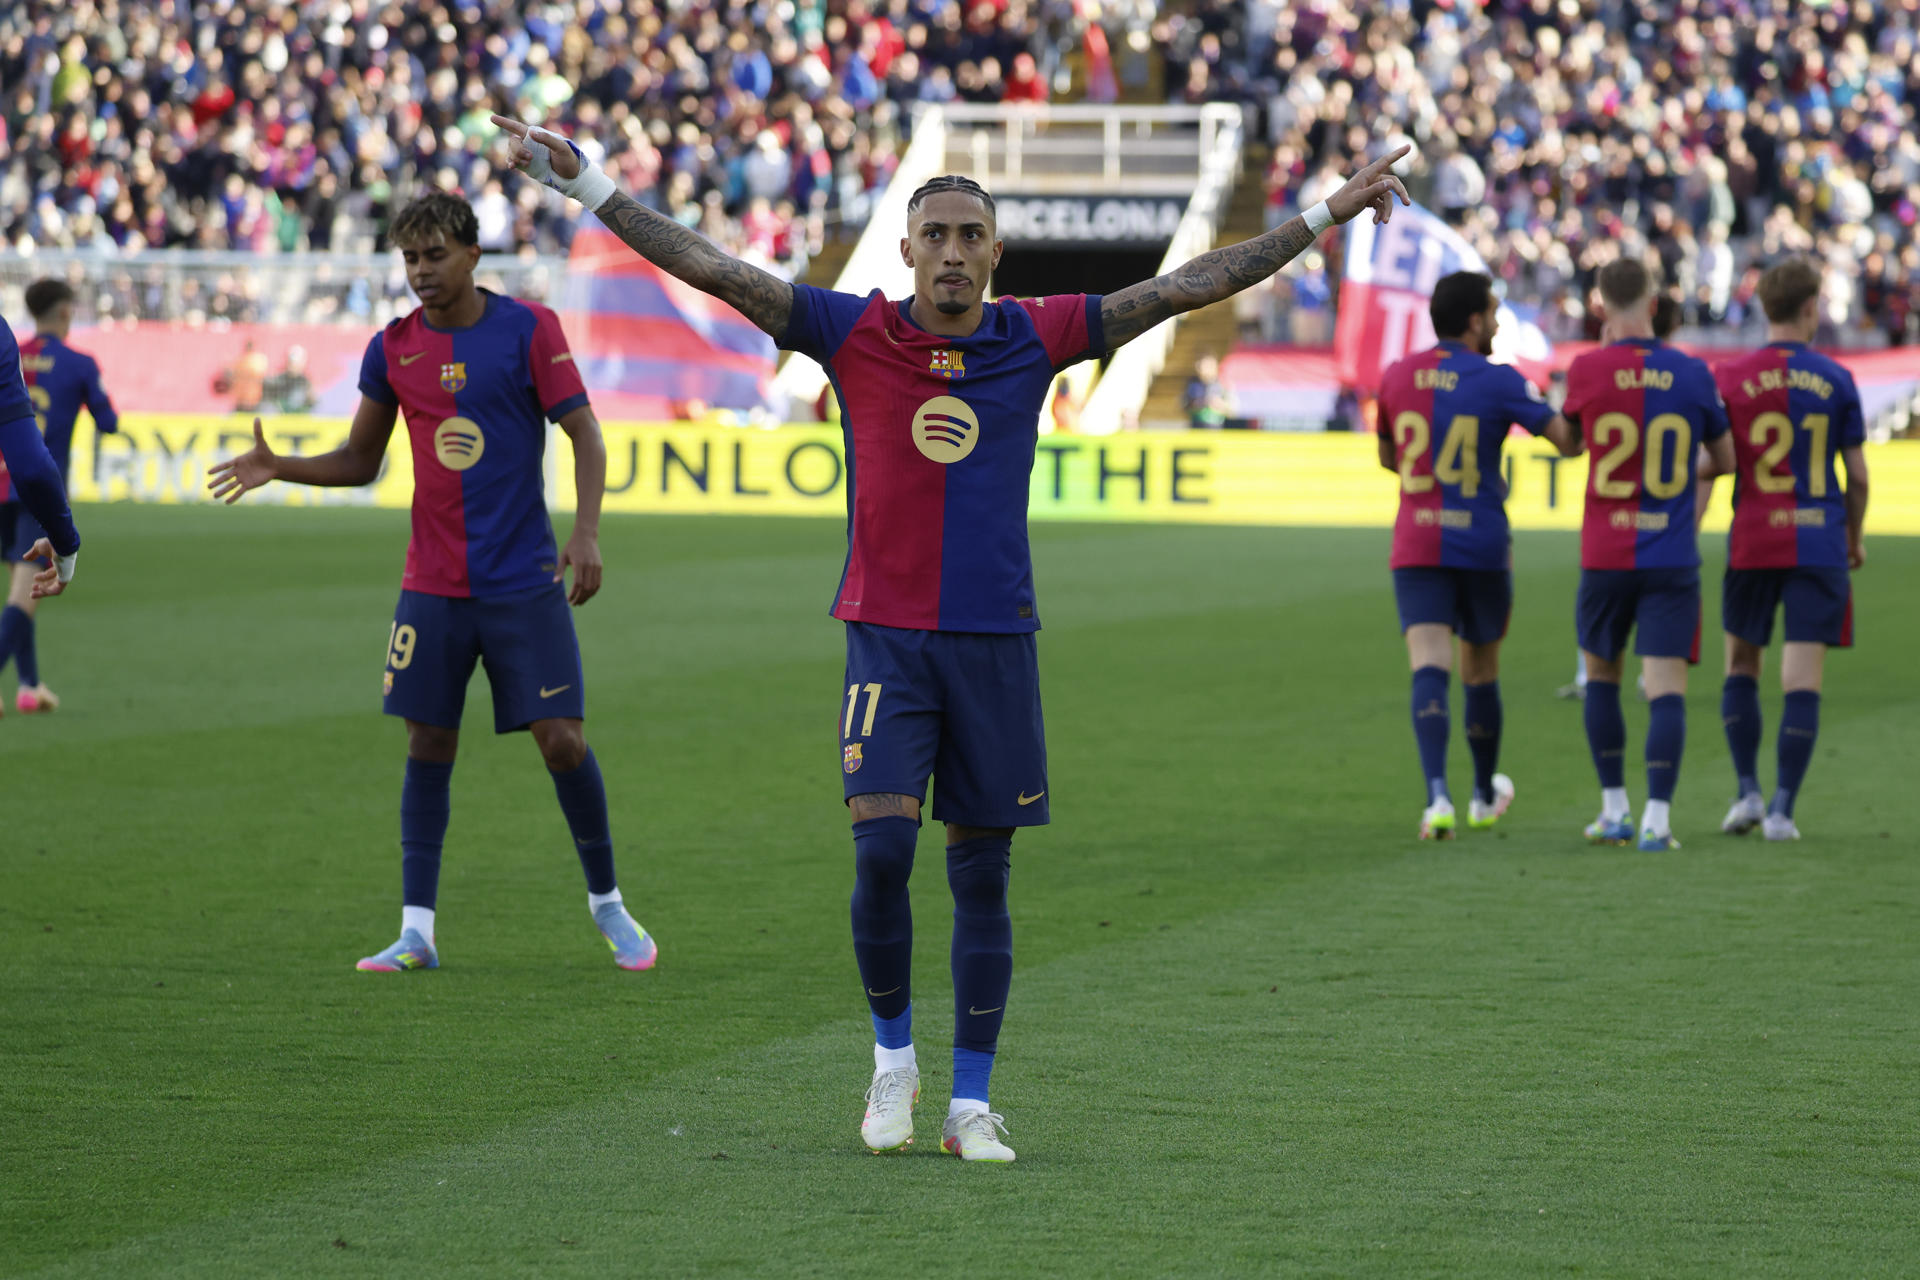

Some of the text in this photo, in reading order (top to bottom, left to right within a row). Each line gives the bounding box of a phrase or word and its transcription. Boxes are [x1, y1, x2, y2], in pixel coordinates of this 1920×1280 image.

[1414, 369, 1459, 392] ERIC
[1614, 369, 1675, 391] OLMO
[1036, 446, 1210, 503] THE
[1394, 410, 1480, 498] 24
[1593, 411, 1692, 499] 20
[1751, 411, 1830, 498] 21
[845, 682, 882, 739] 11
